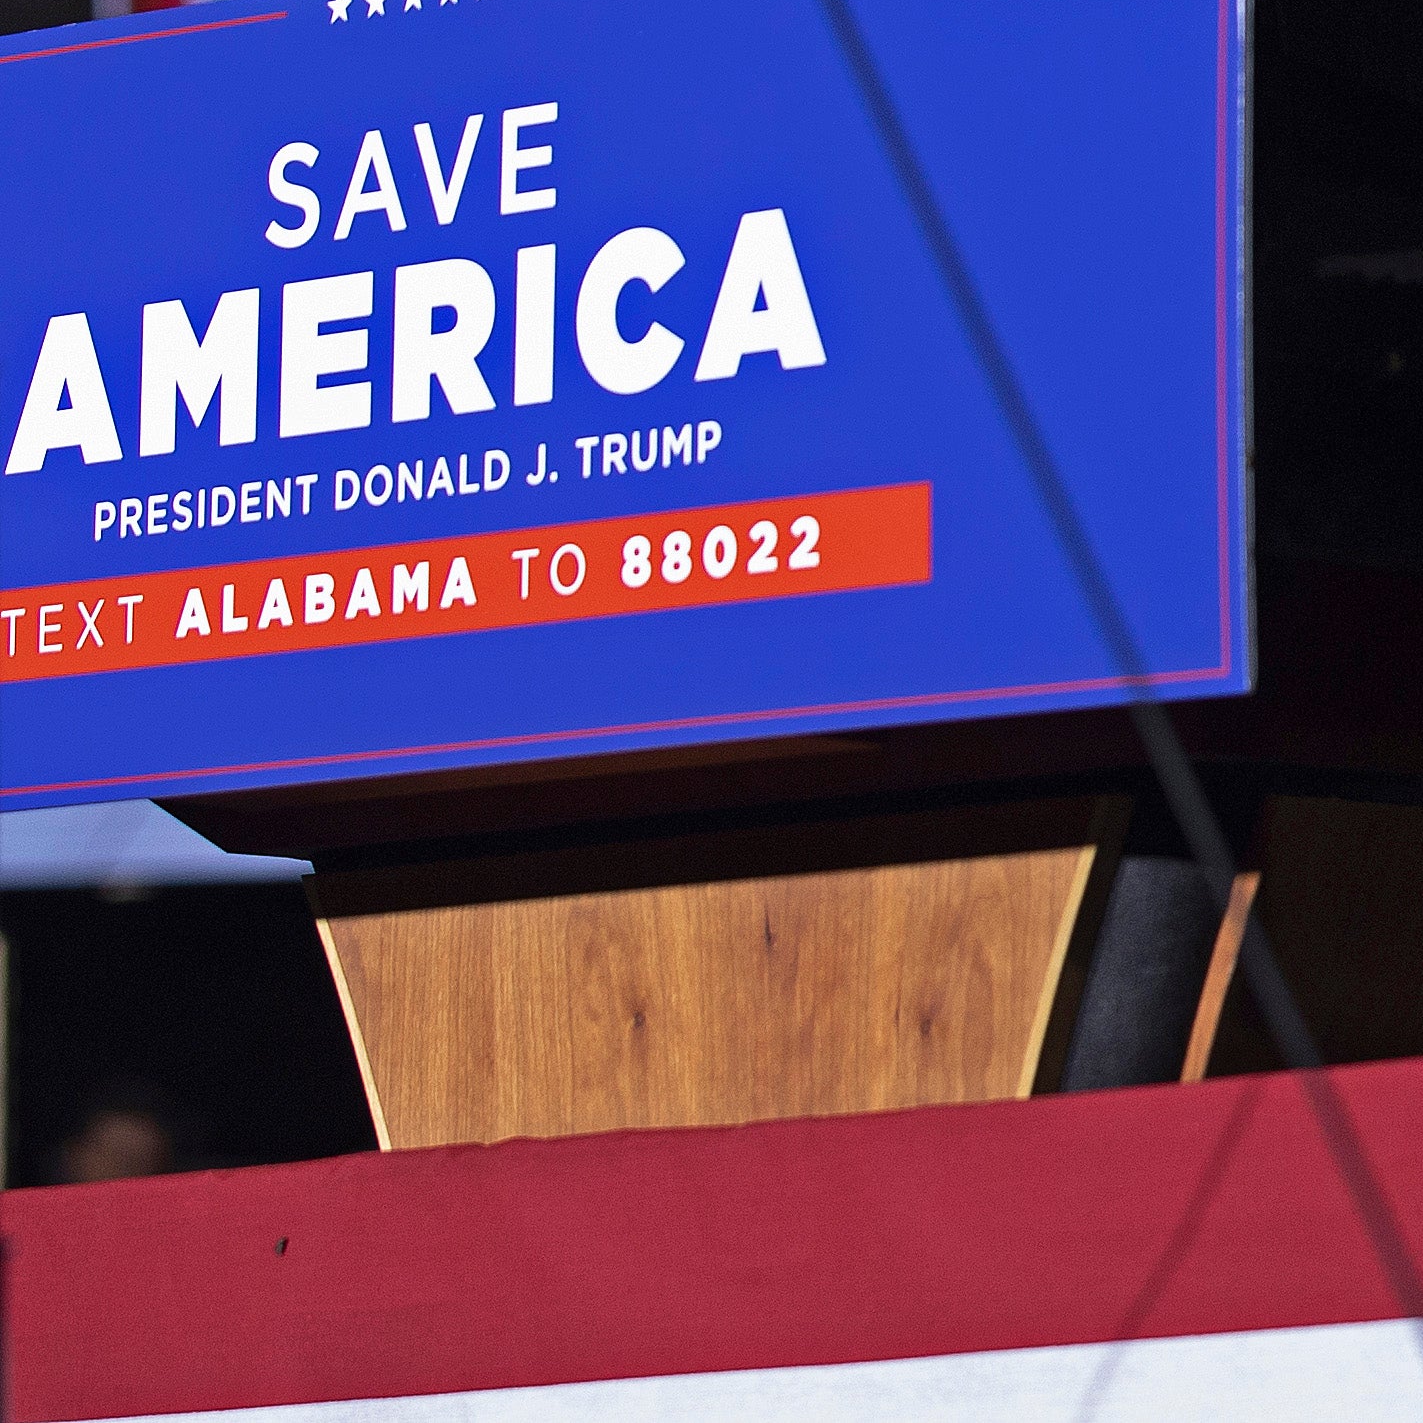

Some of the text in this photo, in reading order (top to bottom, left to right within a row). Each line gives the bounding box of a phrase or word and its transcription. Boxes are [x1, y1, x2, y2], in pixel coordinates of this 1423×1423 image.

[264, 101, 558, 249] SAVE
[4, 208, 828, 476] AMERICA
[94, 420, 722, 543] PRESIDENT DONALD J. TRUMP
[0, 515, 820, 658] TEXT ALABAMA TO 88022
